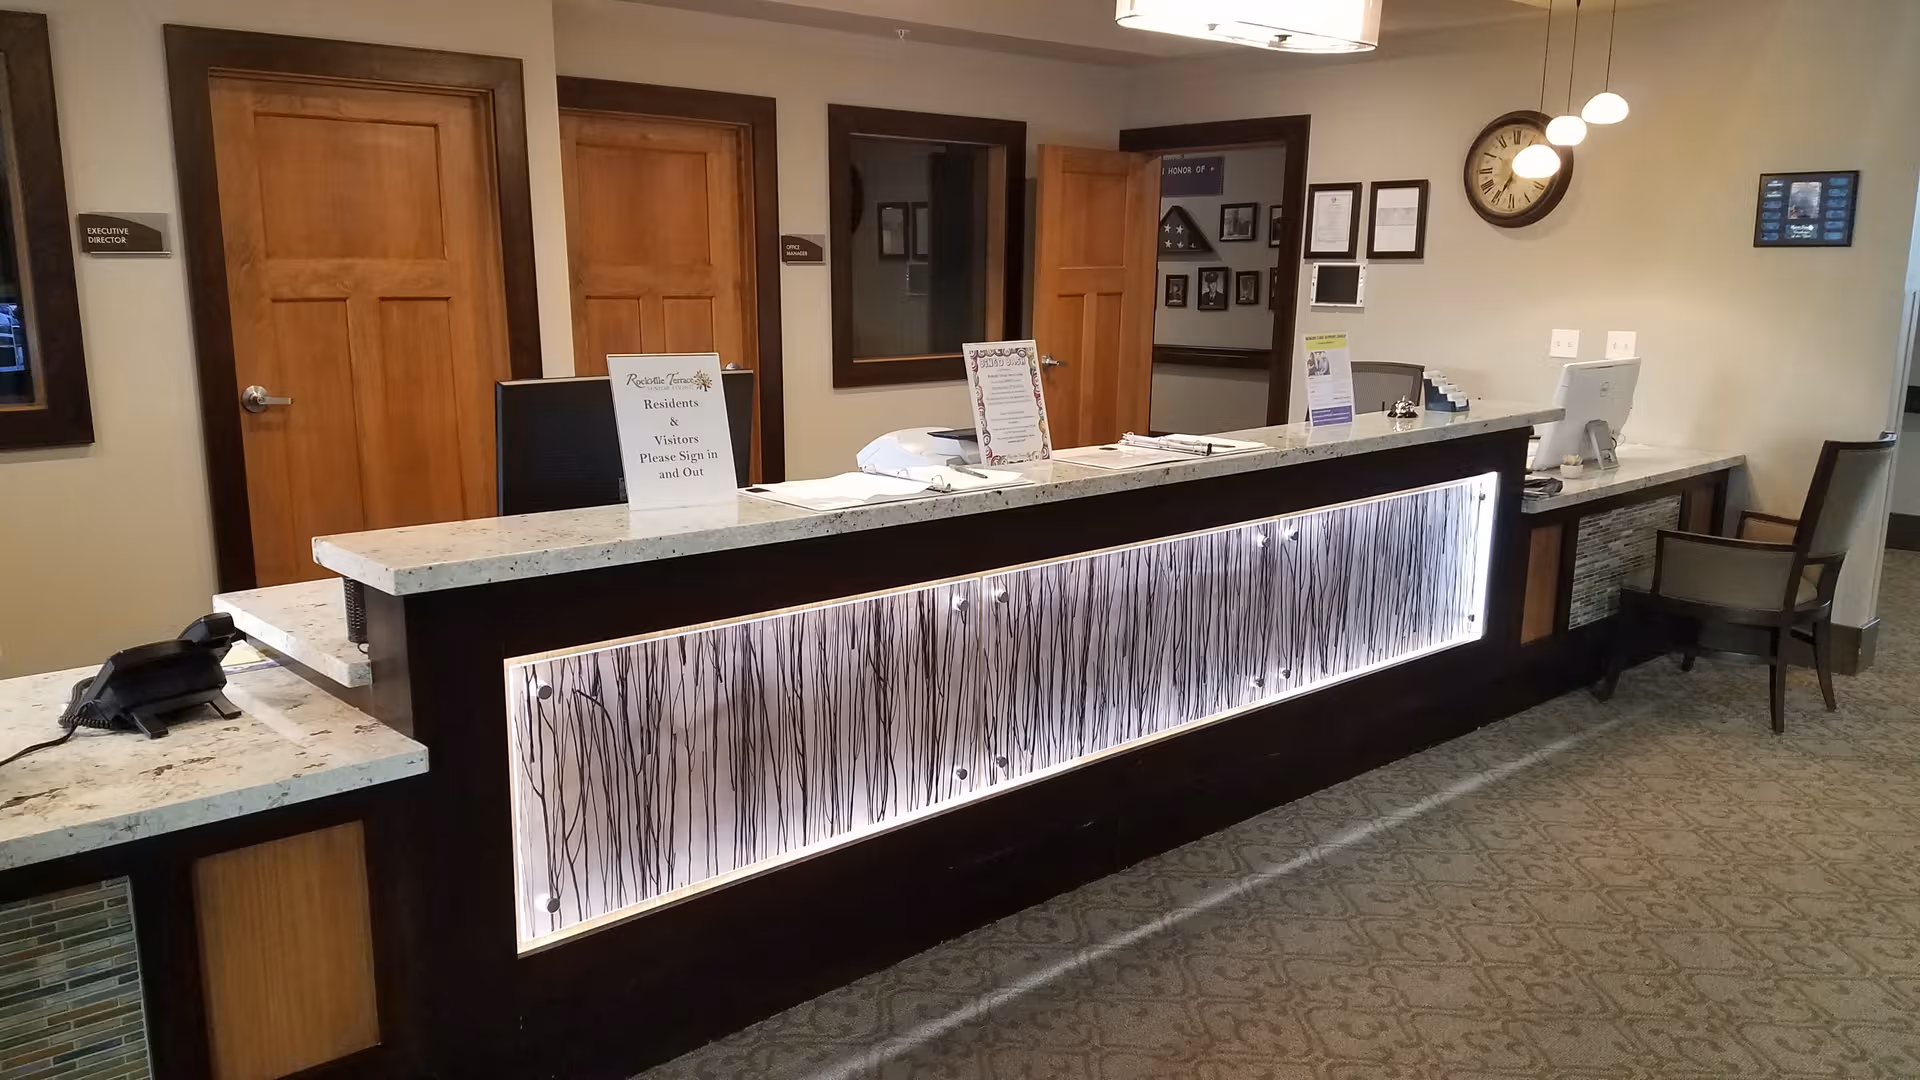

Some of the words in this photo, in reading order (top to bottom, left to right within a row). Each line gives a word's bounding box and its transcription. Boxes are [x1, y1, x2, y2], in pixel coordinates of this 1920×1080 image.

[1168, 166, 1192, 175] HONOR
[1195, 165, 1206, 174] OF
[87, 227, 129, 235] EXECUTIVE
[88, 236, 127, 244] DIRECTOR
[980, 358, 1004, 369] BINGO
[1006, 356, 1027, 367] BASH
[626, 373, 665, 389] Rockville
[666, 371, 695, 386] Terrace
[643, 398, 699, 410] Residents
[669, 416, 679, 427] &
[653, 434, 699, 446] Visitors
[639, 453, 677, 464] Please
[679, 450, 705, 463] Sign
[707, 449, 718, 459] in
[659, 467, 679, 479] and
[682, 467, 704, 477] Out
